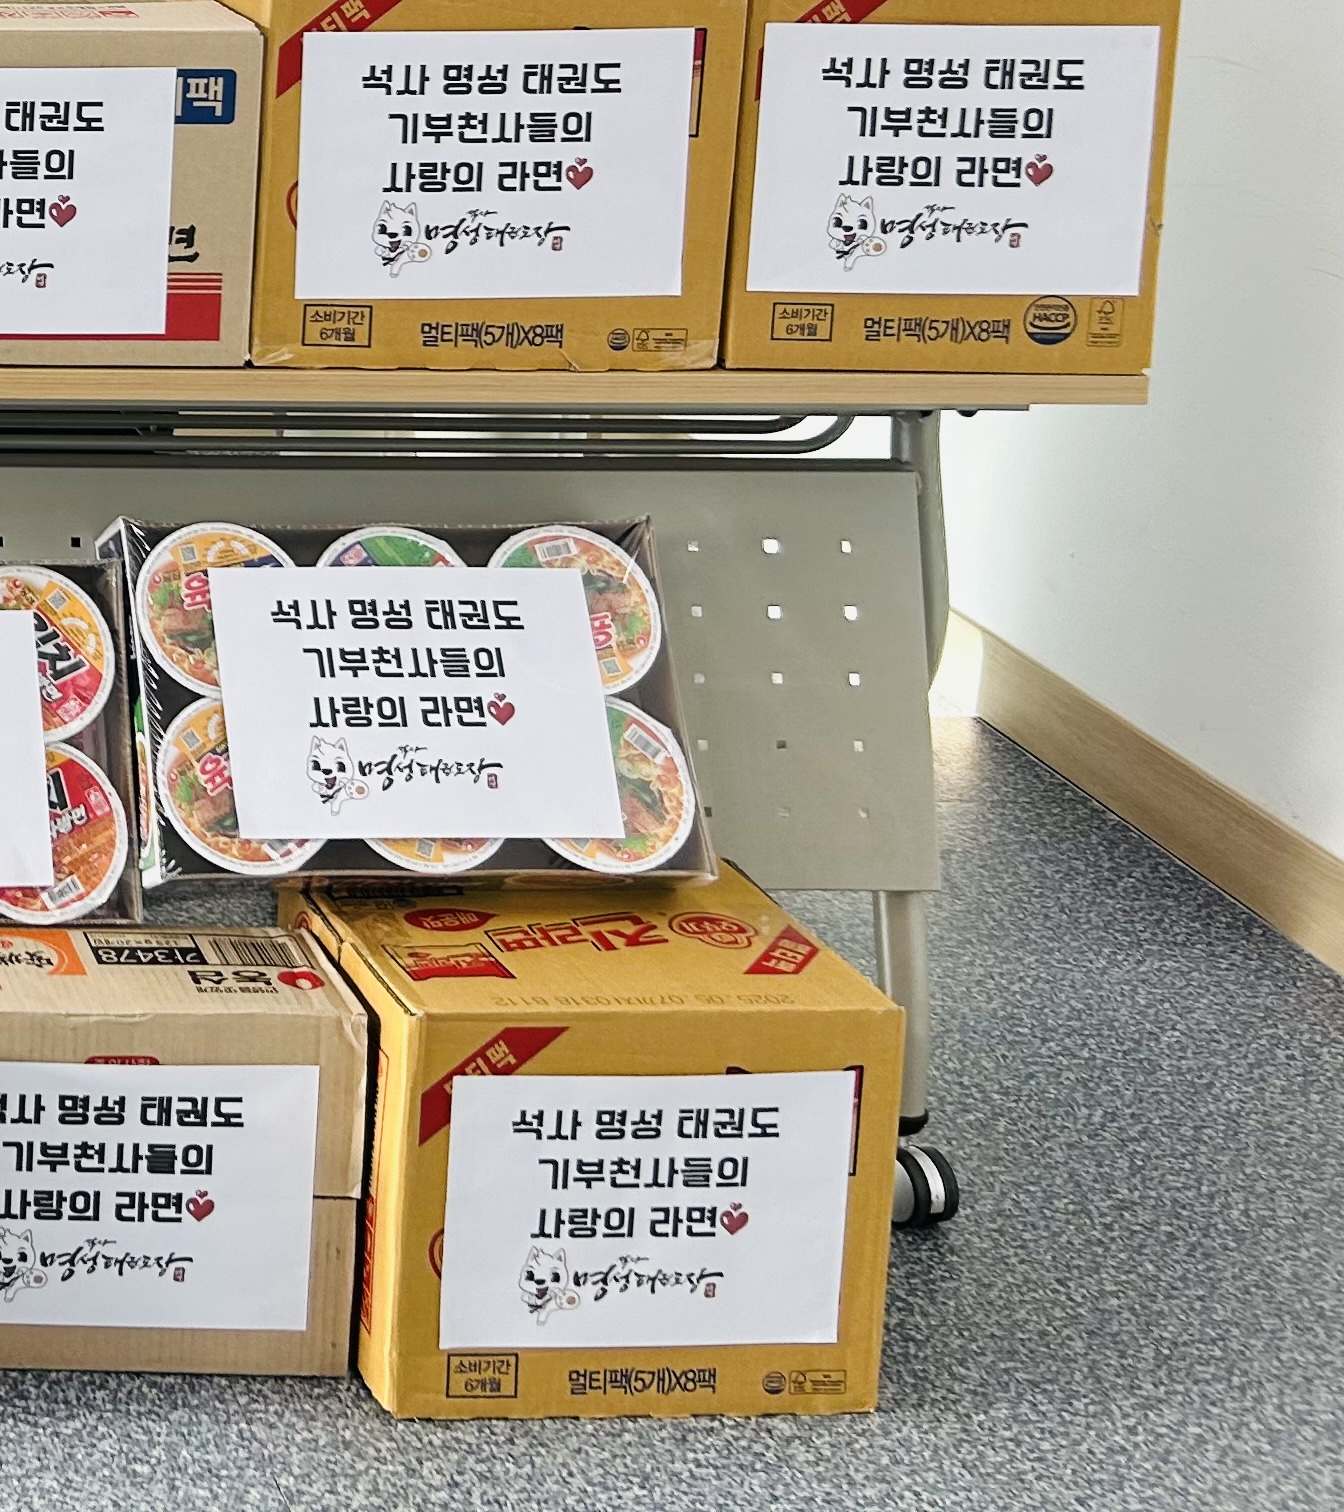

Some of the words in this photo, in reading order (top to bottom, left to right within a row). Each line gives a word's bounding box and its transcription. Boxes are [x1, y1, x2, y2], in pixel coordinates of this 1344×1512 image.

[362, 65, 429, 95] 석사
[443, 64, 508, 95] 명성
[523, 63, 621, 94] 태권도
[822, 57, 890, 88] 석사
[904, 59, 969, 89] 명성
[985, 59, 1084, 90] 태권도
[5, 101, 104, 131] 태권도
[389, 112, 592, 144] 기부천사들의
[847, 106, 1053, 138] 기부천사들의
[382, 162, 483, 192] 사랑의
[498, 161, 568, 191] 라면
[839, 156, 941, 186] 사랑의
[957, 157, 1028, 187] 라면
[309, 309, 366, 326] 소비기간
[778, 307, 829, 321] 소비기간
[320, 326, 355, 343] 6개월
[271, 600, 337, 629] 석사
[348, 599, 412, 629] 명성
[425, 600, 524, 629] 태권도
[303, 646, 505, 678] 기부천사들의
[310, 697, 408, 727] 사랑의
[420, 697, 488, 727] 라면
[58, 1095, 125, 1125] 명성
[140, 1096, 244, 1127] 태권도
[512, 1110, 582, 1140] 석사
[596, 1110, 662, 1140] 명성
[678, 1107, 779, 1138] 태권도
[3, 1141, 213, 1175] 기부천사들의
[539, 1157, 748, 1189] 기부천사들의
[115, 1191, 187, 1223] 라면
[531, 1207, 634, 1238] 사랑의
[650, 1205, 722, 1236] 라면
[453, 1359, 512, 1376] 소비기간
[464, 1377, 502, 1393] 6개월
